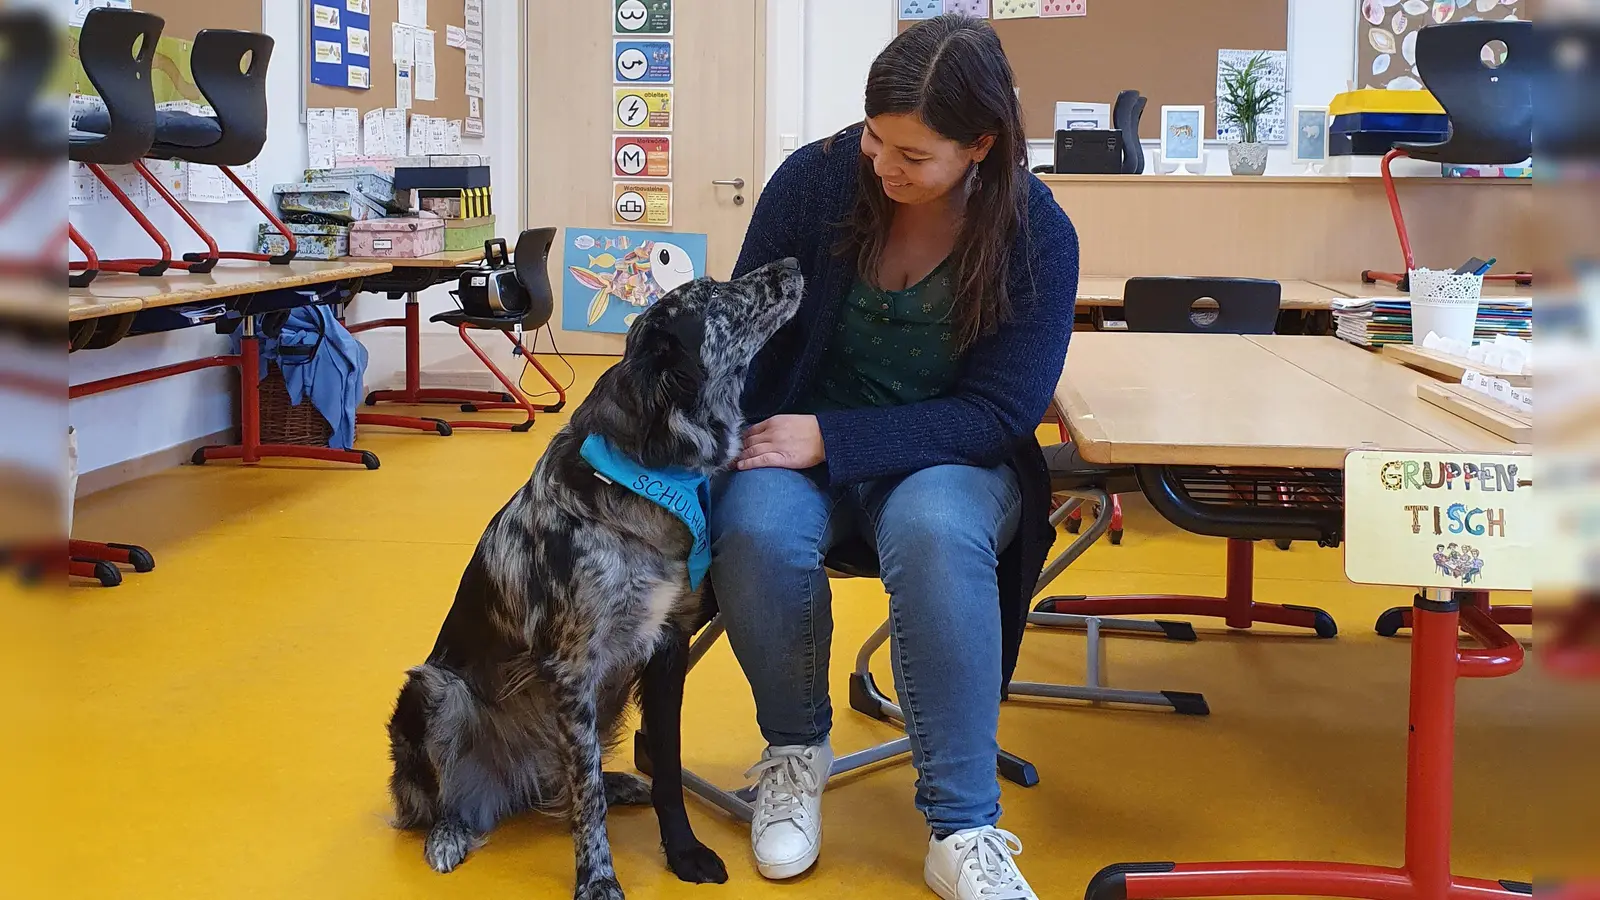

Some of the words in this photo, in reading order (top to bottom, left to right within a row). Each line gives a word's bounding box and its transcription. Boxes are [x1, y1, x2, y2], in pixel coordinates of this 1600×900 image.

[623, 150, 640, 167] M
[1381, 460, 1532, 491] GRUPPEN-
[1404, 503, 1505, 537] TISCH
